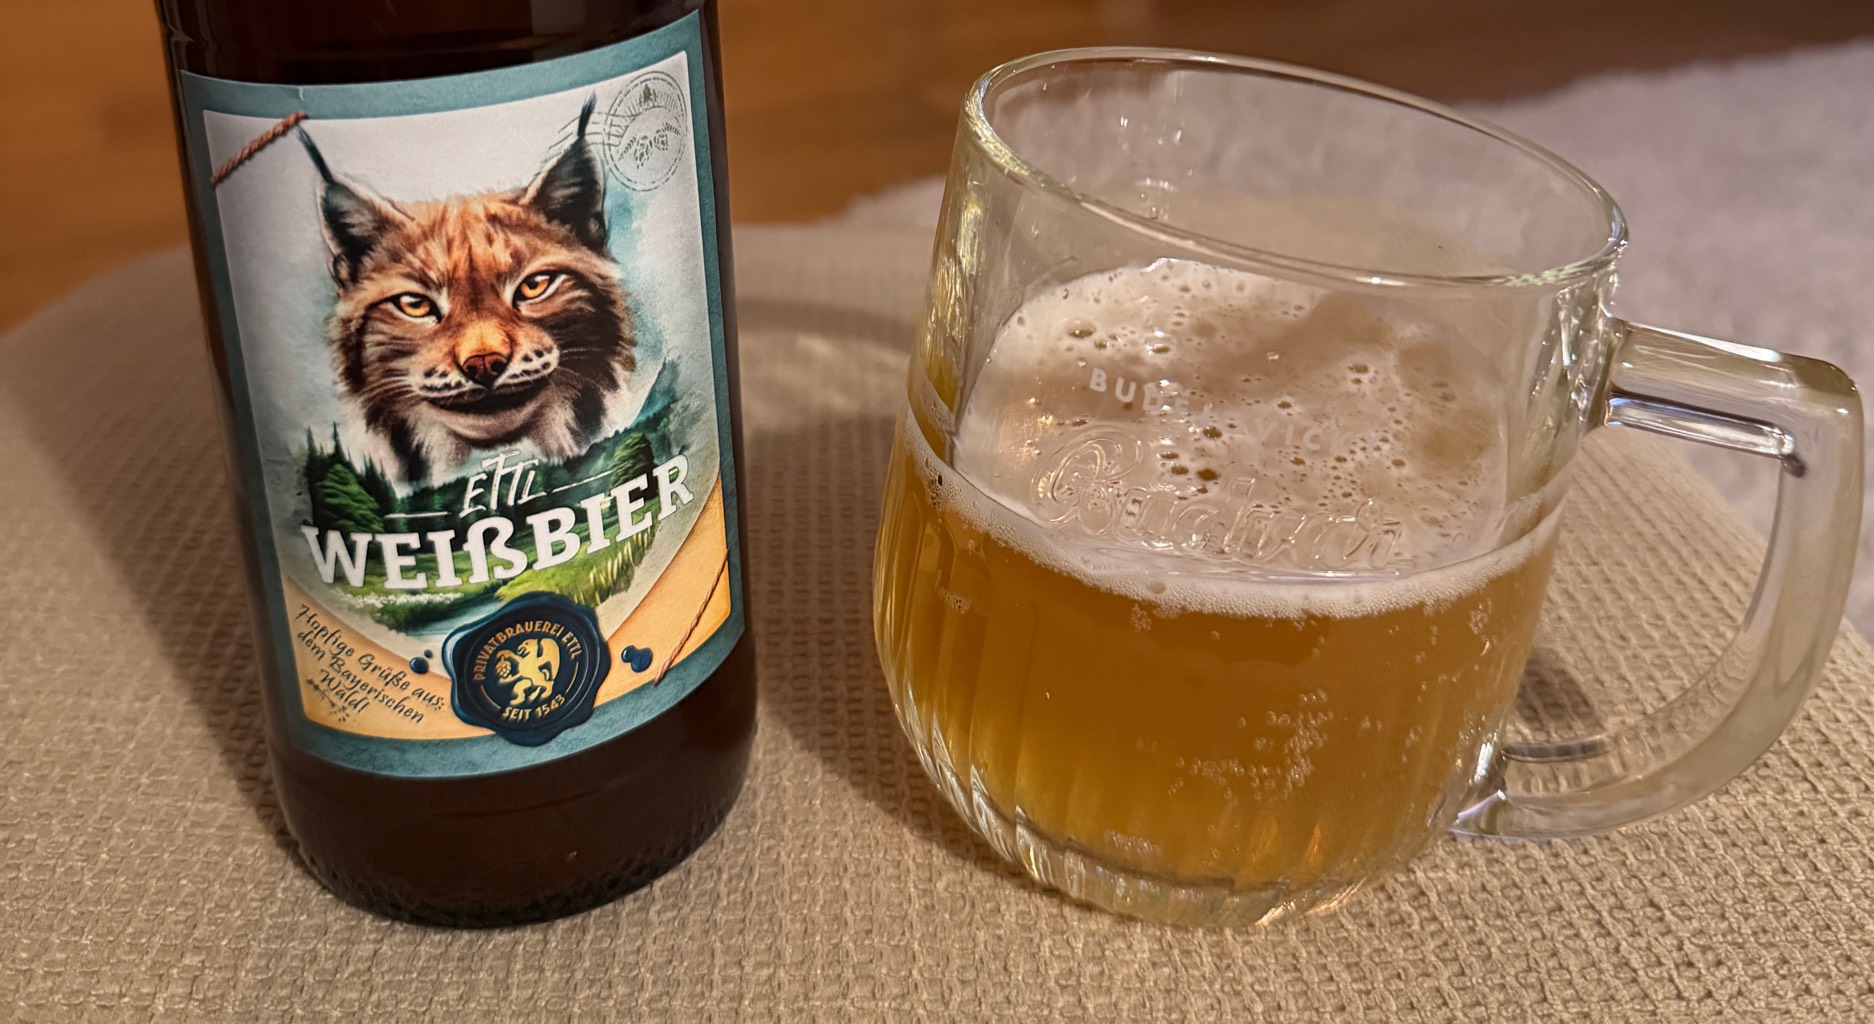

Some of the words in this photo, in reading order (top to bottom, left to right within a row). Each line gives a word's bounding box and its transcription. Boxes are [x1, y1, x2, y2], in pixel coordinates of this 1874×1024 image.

[458, 448, 547, 520] ETTL
[301, 453, 695, 590] WEIßBIER
[294, 604, 355, 657] Hopfige
[358, 653, 411, 691] Grüße
[297, 629, 326, 661] dem
[328, 655, 425, 724] Bayerischen
[473, 620, 565, 682] PRIVATBRAUEREI
[561, 631, 583, 662] ETTL
[319, 668, 370, 714] Wald!
[501, 706, 532, 721] SEIT
[535, 693, 566, 719] 1543
